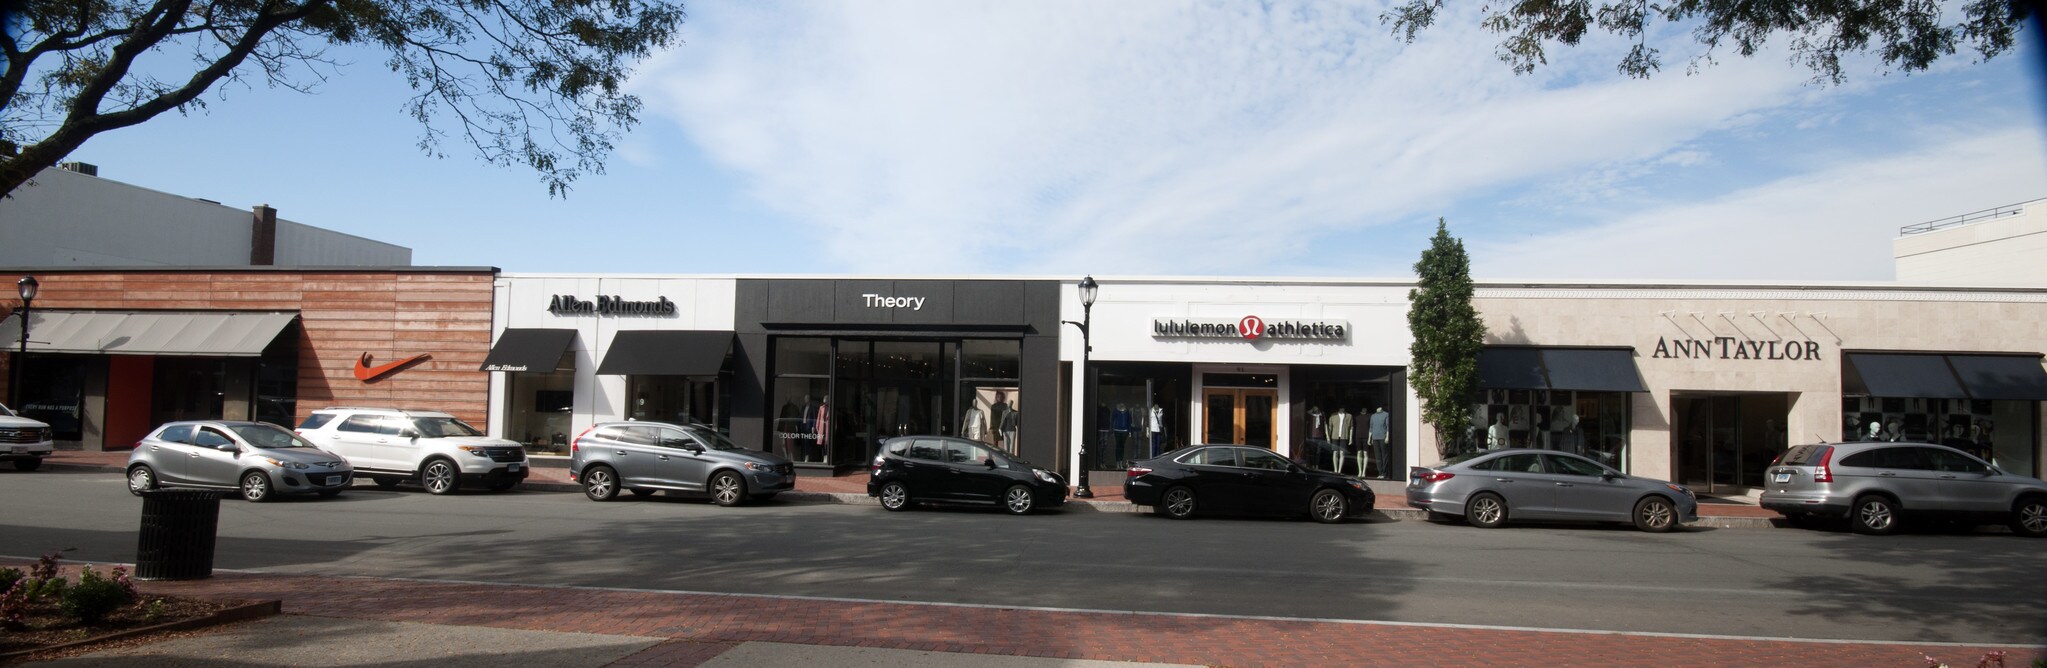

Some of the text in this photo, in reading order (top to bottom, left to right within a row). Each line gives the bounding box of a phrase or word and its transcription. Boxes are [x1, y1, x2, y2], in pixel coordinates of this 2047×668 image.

[547, 294, 676, 316] Allen Edmonds
[862, 293, 925, 311] Theory
[1154, 319, 1345, 337] lululemon athletica
